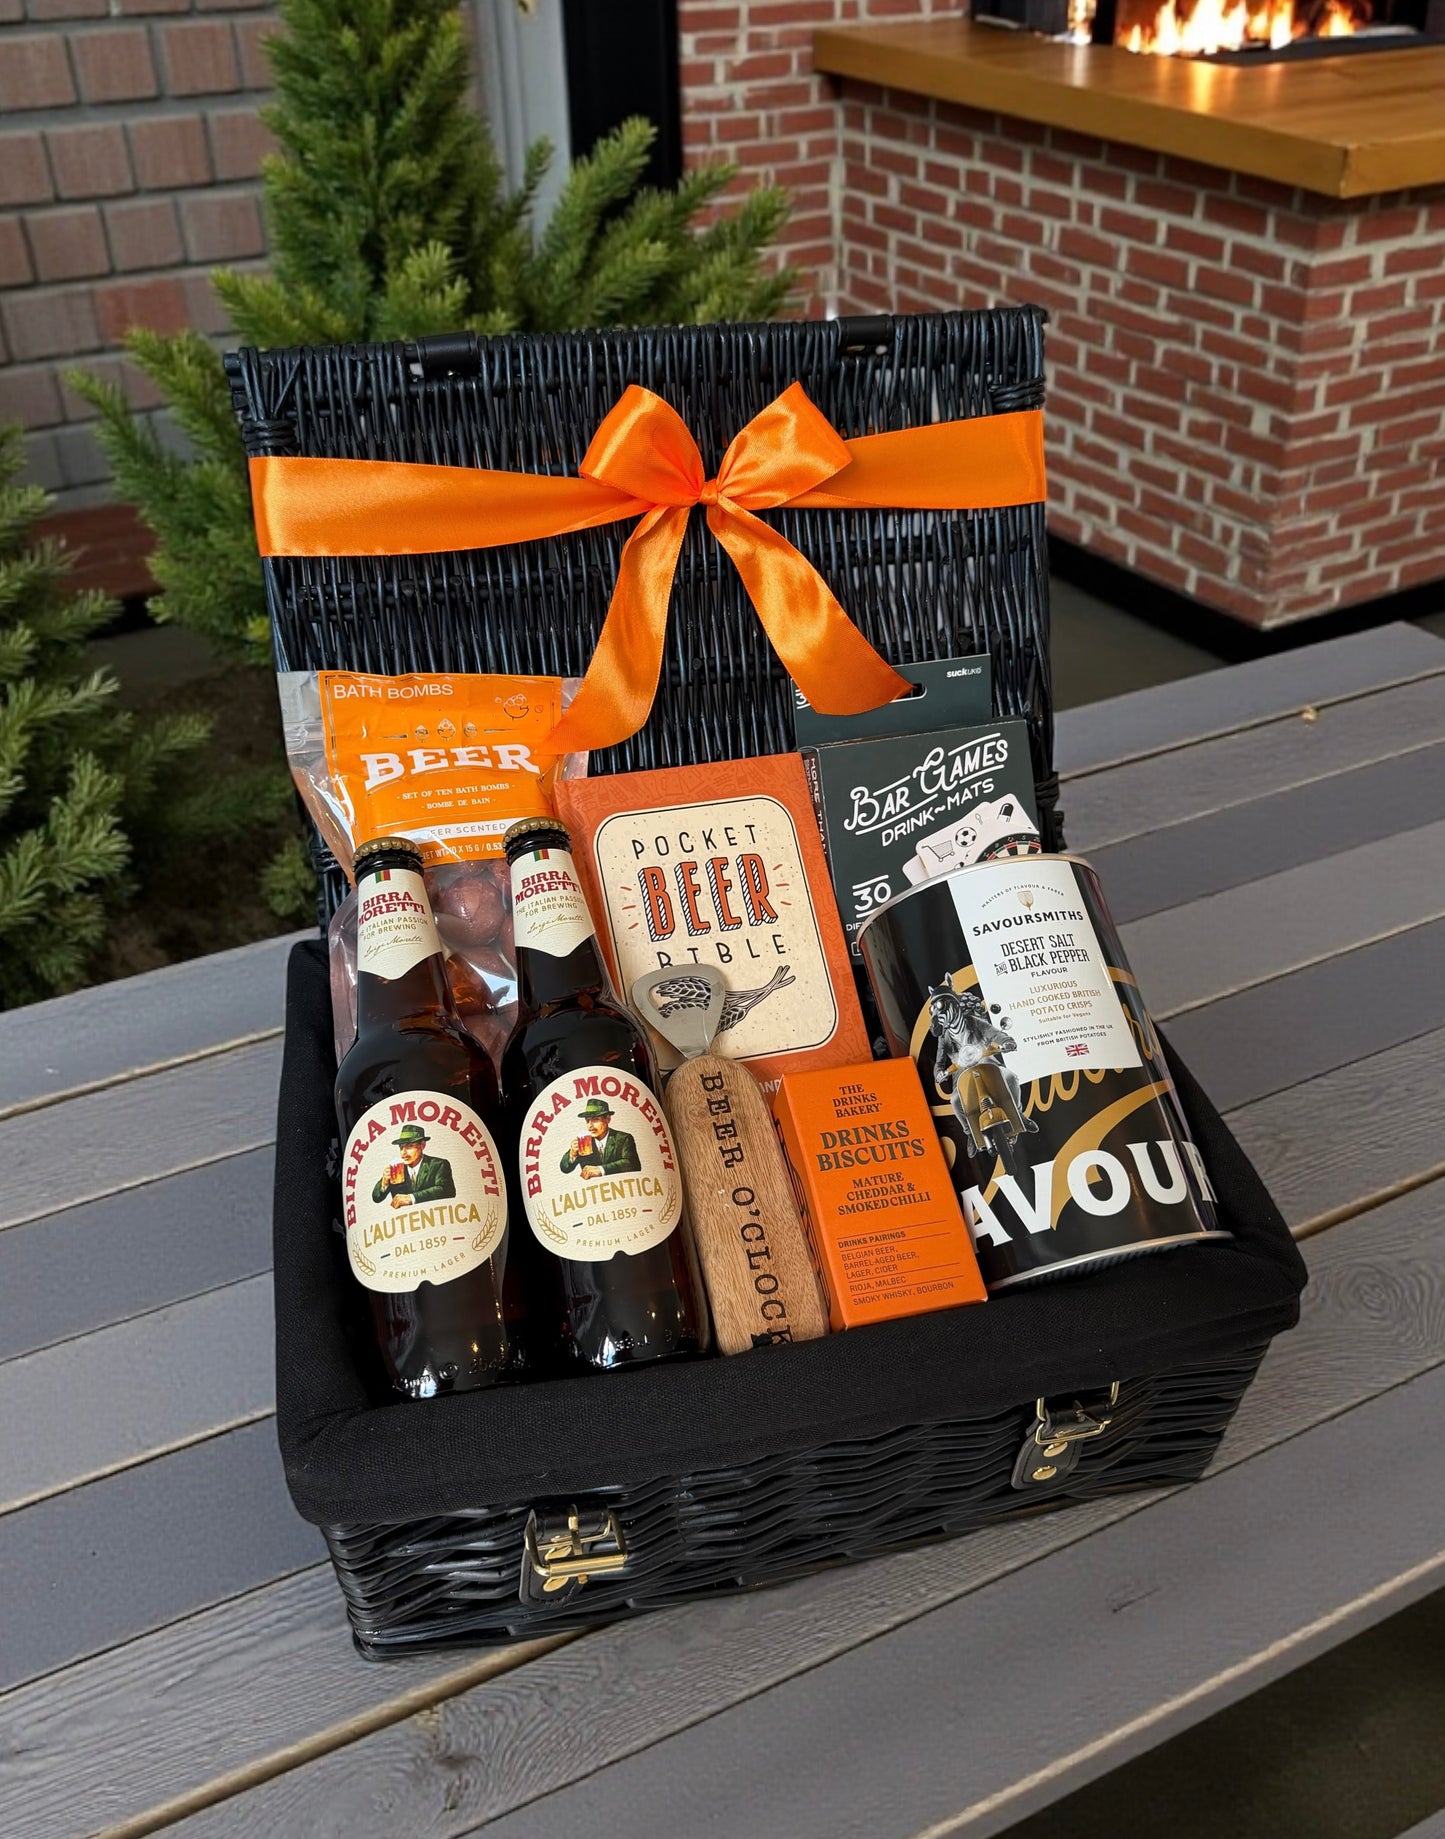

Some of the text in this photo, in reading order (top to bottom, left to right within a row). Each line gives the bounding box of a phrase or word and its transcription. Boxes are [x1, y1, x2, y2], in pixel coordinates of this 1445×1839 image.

[333, 684, 454, 700] BATH BOMBS
[360, 743, 540, 791] BEER
[810, 758, 820, 803] MORE
[844, 739, 1008, 831] BAR GAMES
[402, 783, 510, 800] SET OF TEN BATH BOMBS
[427, 801, 454, 809] BOMBE
[456, 823, 506, 834] SCENTED
[458, 845, 464, 853] X
[632, 824, 756, 860] POCKET
[521, 871, 572, 890] BIRRA
[362, 892, 414, 912] BIRRA
[515, 881, 582, 906] MORETTI
[528, 896, 556, 909] ITALIAN
[637, 854, 779, 942] BEER
[852, 882, 892, 911] 30
[982, 891, 1004, 908] MASTERS
[358, 902, 426, 926] MORETTI
[526, 903, 578, 918] FOR BREWING
[364, 932, 375, 941] FOR
[378, 924, 416, 934] BREWING
[366, 918, 394, 932] ITALIAN
[972, 910, 1084, 937] SAVOURSMITHS
[656, 934, 786, 969] BIBLE
[1000, 934, 1075, 957] DESERT SALT
[996, 948, 1090, 974] AND BLACK PEPPER
[1031, 967, 1068, 978] FLAVOUR
[1030, 980, 1078, 994] LUXURIOUS
[1009, 989, 1101, 1010] HAND COOKED BRITISH
[1030, 1000, 1093, 1016] POTATO CRISPS
[1023, 1032, 1054, 1042] STYLISHLY
[1056, 1026, 1088, 1035] FASHIONED
[1037, 1039, 1054, 1047] FROM
[1056, 1035, 1078, 1043] BRITISH
[839, 1084, 864, 1095] THE
[832, 1092, 877, 1108] DRINKS
[700, 1072, 744, 1168] BEER
[836, 1104, 880, 1118] BAKERY
[526, 1075, 676, 1198] BIRRA MORETTI
[820, 1120, 910, 1150] DRINKS
[346, 1100, 500, 1230] BIRRA MORETTI
[816, 1138, 925, 1172] BISCUITS
[852, 1172, 904, 1188] MATURE
[552, 1177, 664, 1218] L'AUTENTICA
[846, 1182, 916, 1202] CHEDDAR &
[838, 1192, 931, 1216] SMOKED CHILLI
[363, 1203, 480, 1248] L'AUTENTICA
[587, 1207, 638, 1226] DAL 1859
[576, 1224, 656, 1247] PREMIUM LAGER
[838, 1231, 906, 1248] DRINKS PAIRINGS
[395, 1235, 447, 1258] DAL 1859
[842, 1246, 898, 1262] BELGIAN BEER,
[382, 1252, 466, 1279] PREMIUM LAGER
[844, 1252, 920, 1270] BARREL-AGED BEER,
[875, 1264, 898, 1273] CIDER
[876, 1276, 907, 1287] MALBEC
[853, 1294, 881, 1306] SMOKY
[917, 1282, 954, 1294] BOURBON
